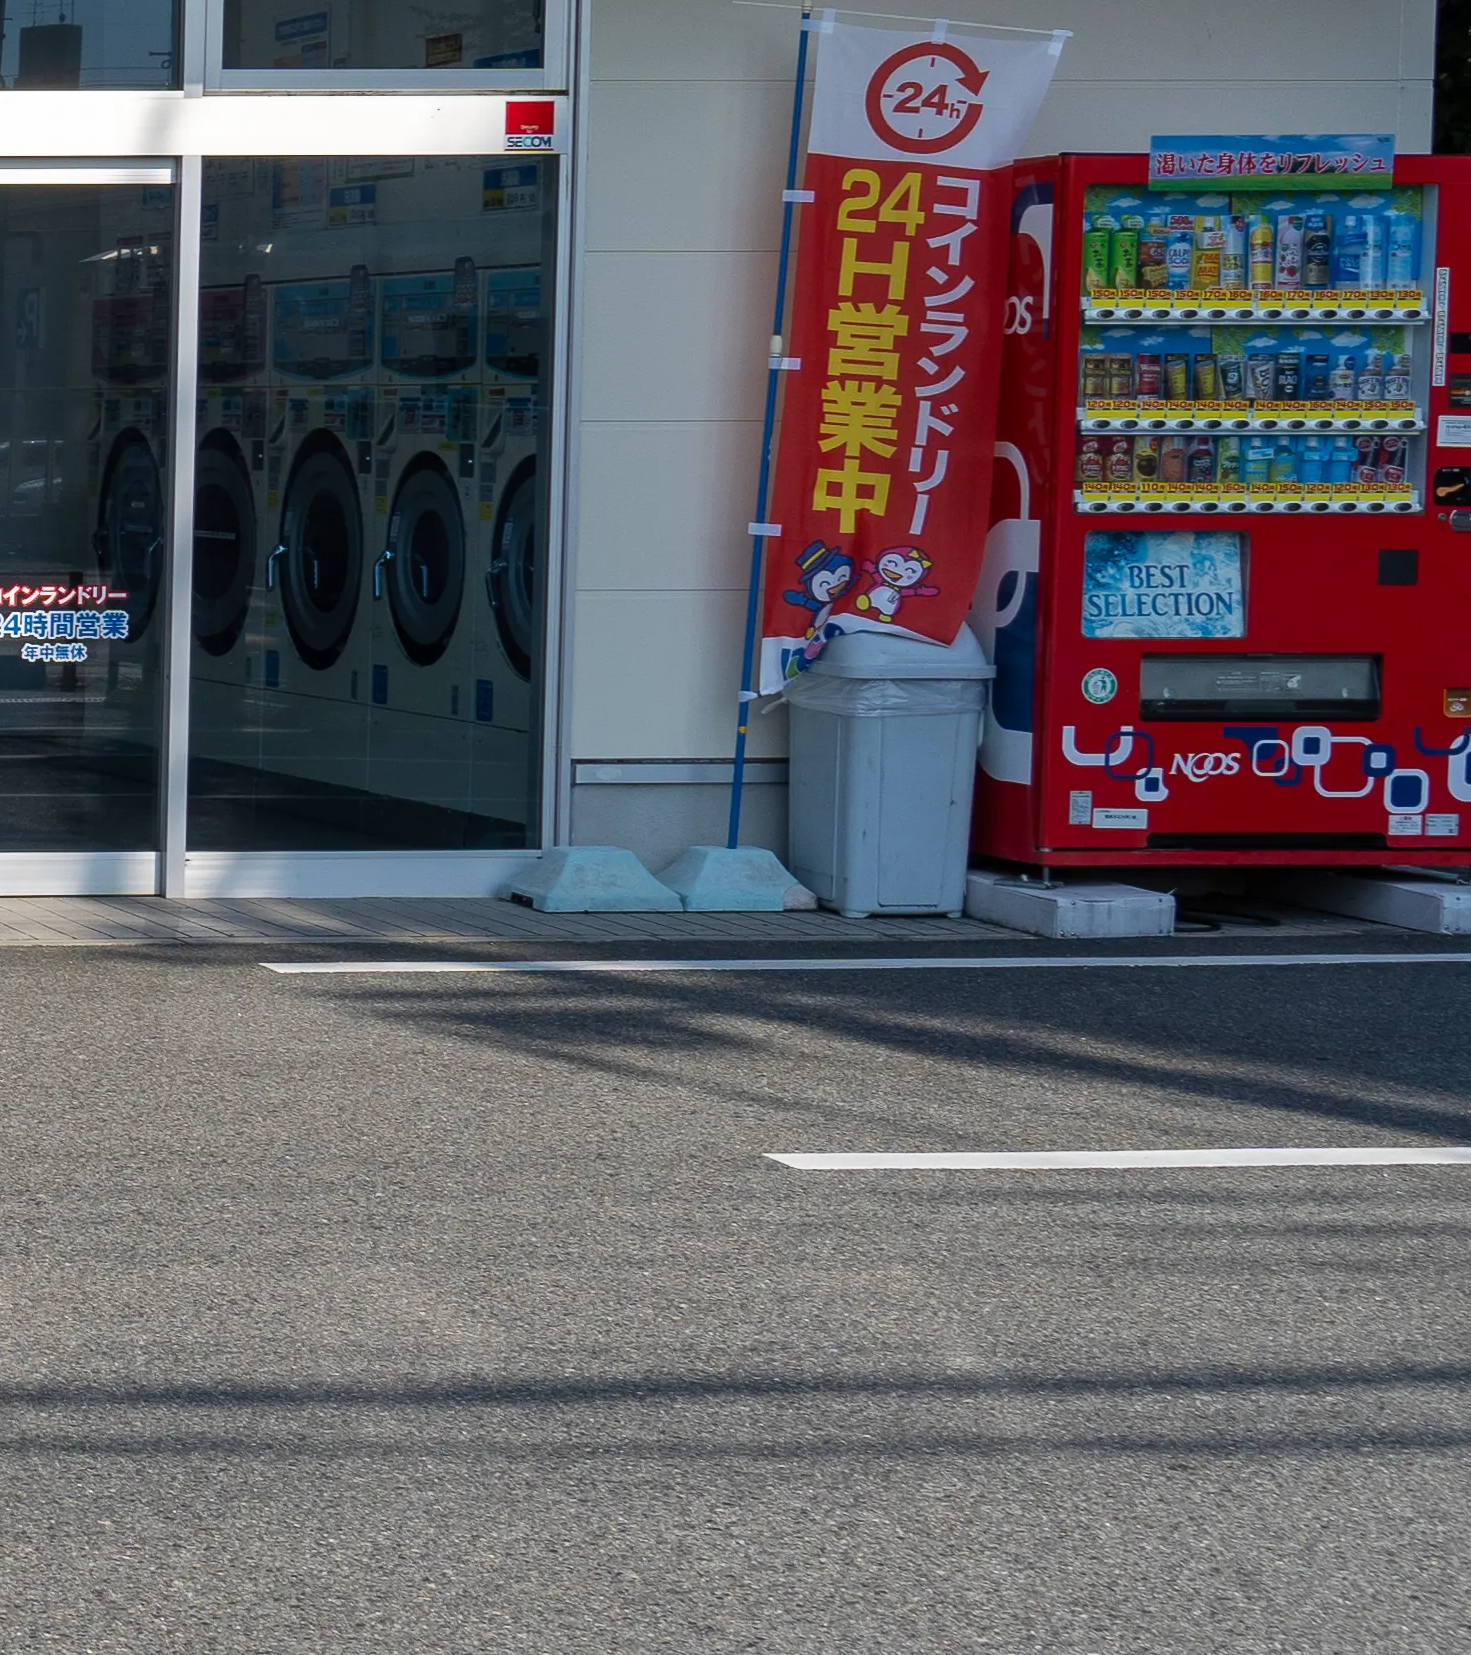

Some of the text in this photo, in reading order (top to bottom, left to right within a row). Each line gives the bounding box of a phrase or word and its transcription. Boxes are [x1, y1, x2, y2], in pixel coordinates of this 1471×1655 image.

[507, 135, 553, 148] SECOM
[1155, 152, 1387, 175] 渇いた身体をリフレッシュ
[811, 168, 926, 535] 24H営業中
[908, 175, 981, 537] コインランドリー
[1127, 564, 1190, 589] BEST
[1087, 591, 1235, 619] SELECTION
[21, 643, 88, 662] 年中無休
